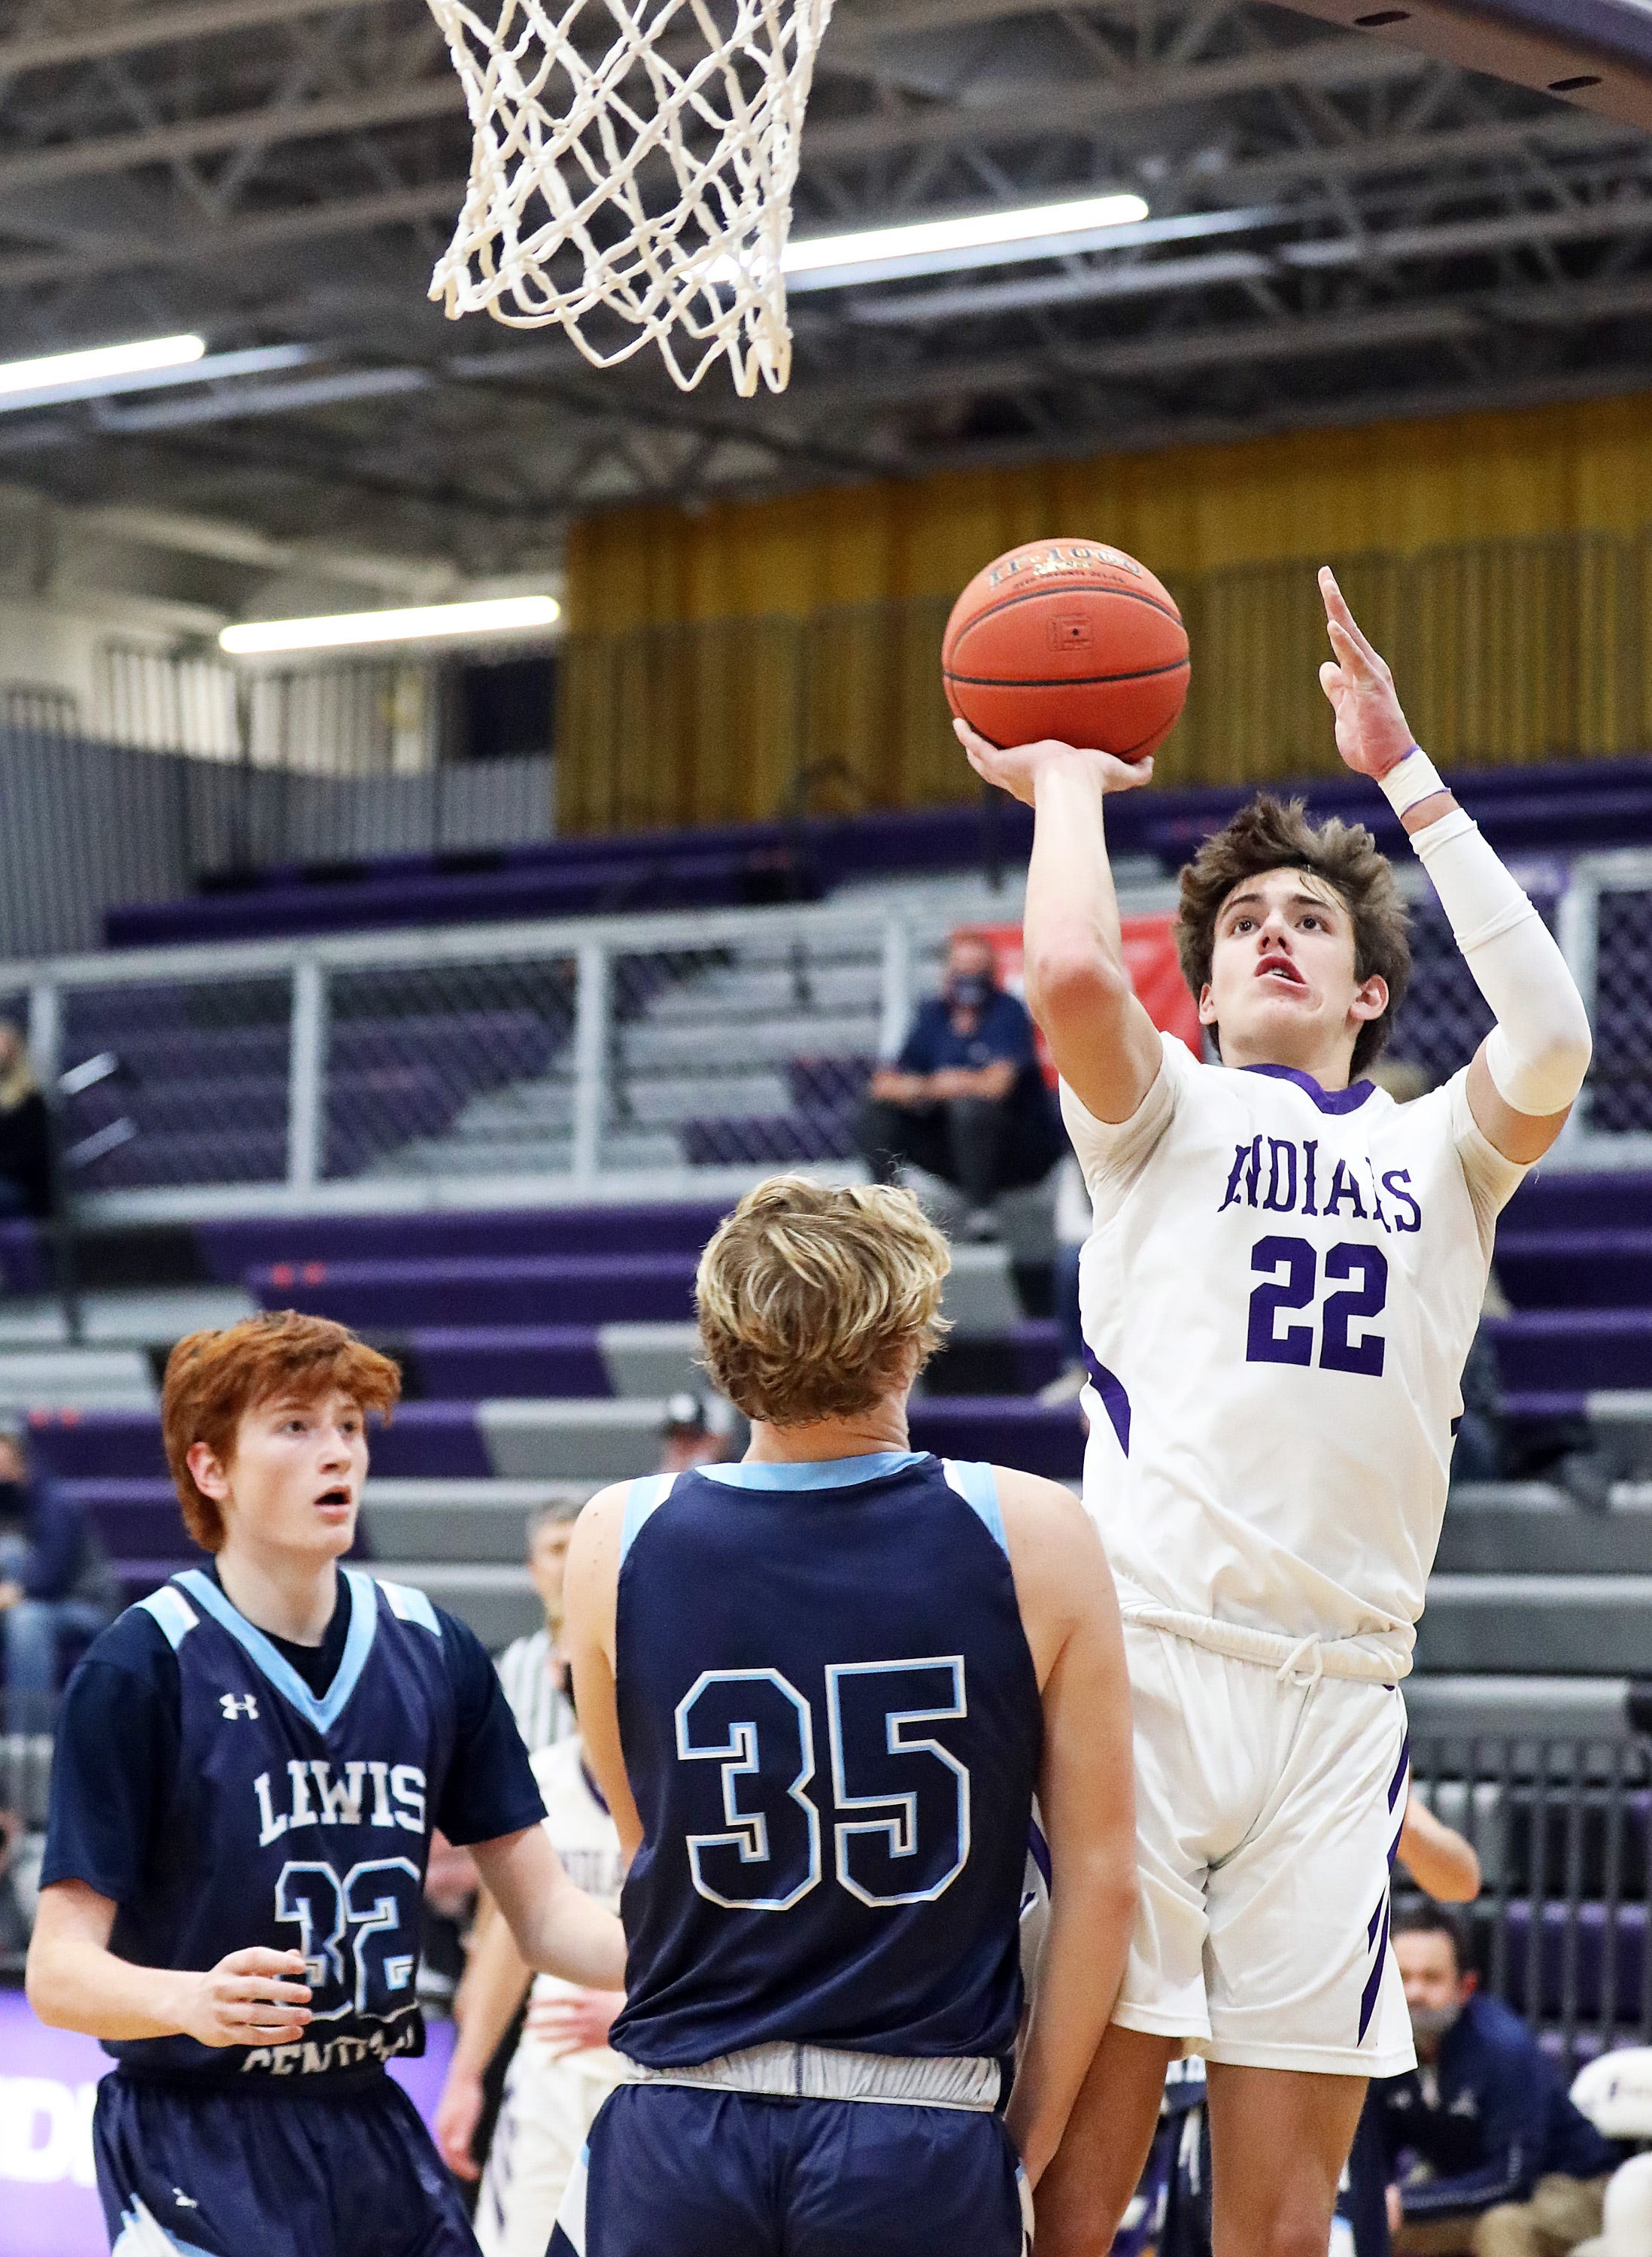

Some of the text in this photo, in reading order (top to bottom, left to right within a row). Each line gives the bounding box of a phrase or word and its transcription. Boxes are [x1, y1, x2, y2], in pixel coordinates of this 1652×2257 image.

[1216, 1134, 1422, 1234] INDIAS
[1246, 1235, 1389, 1378] 22
[674, 1654, 971, 1911] 35
[274, 1857, 422, 2024] 32
